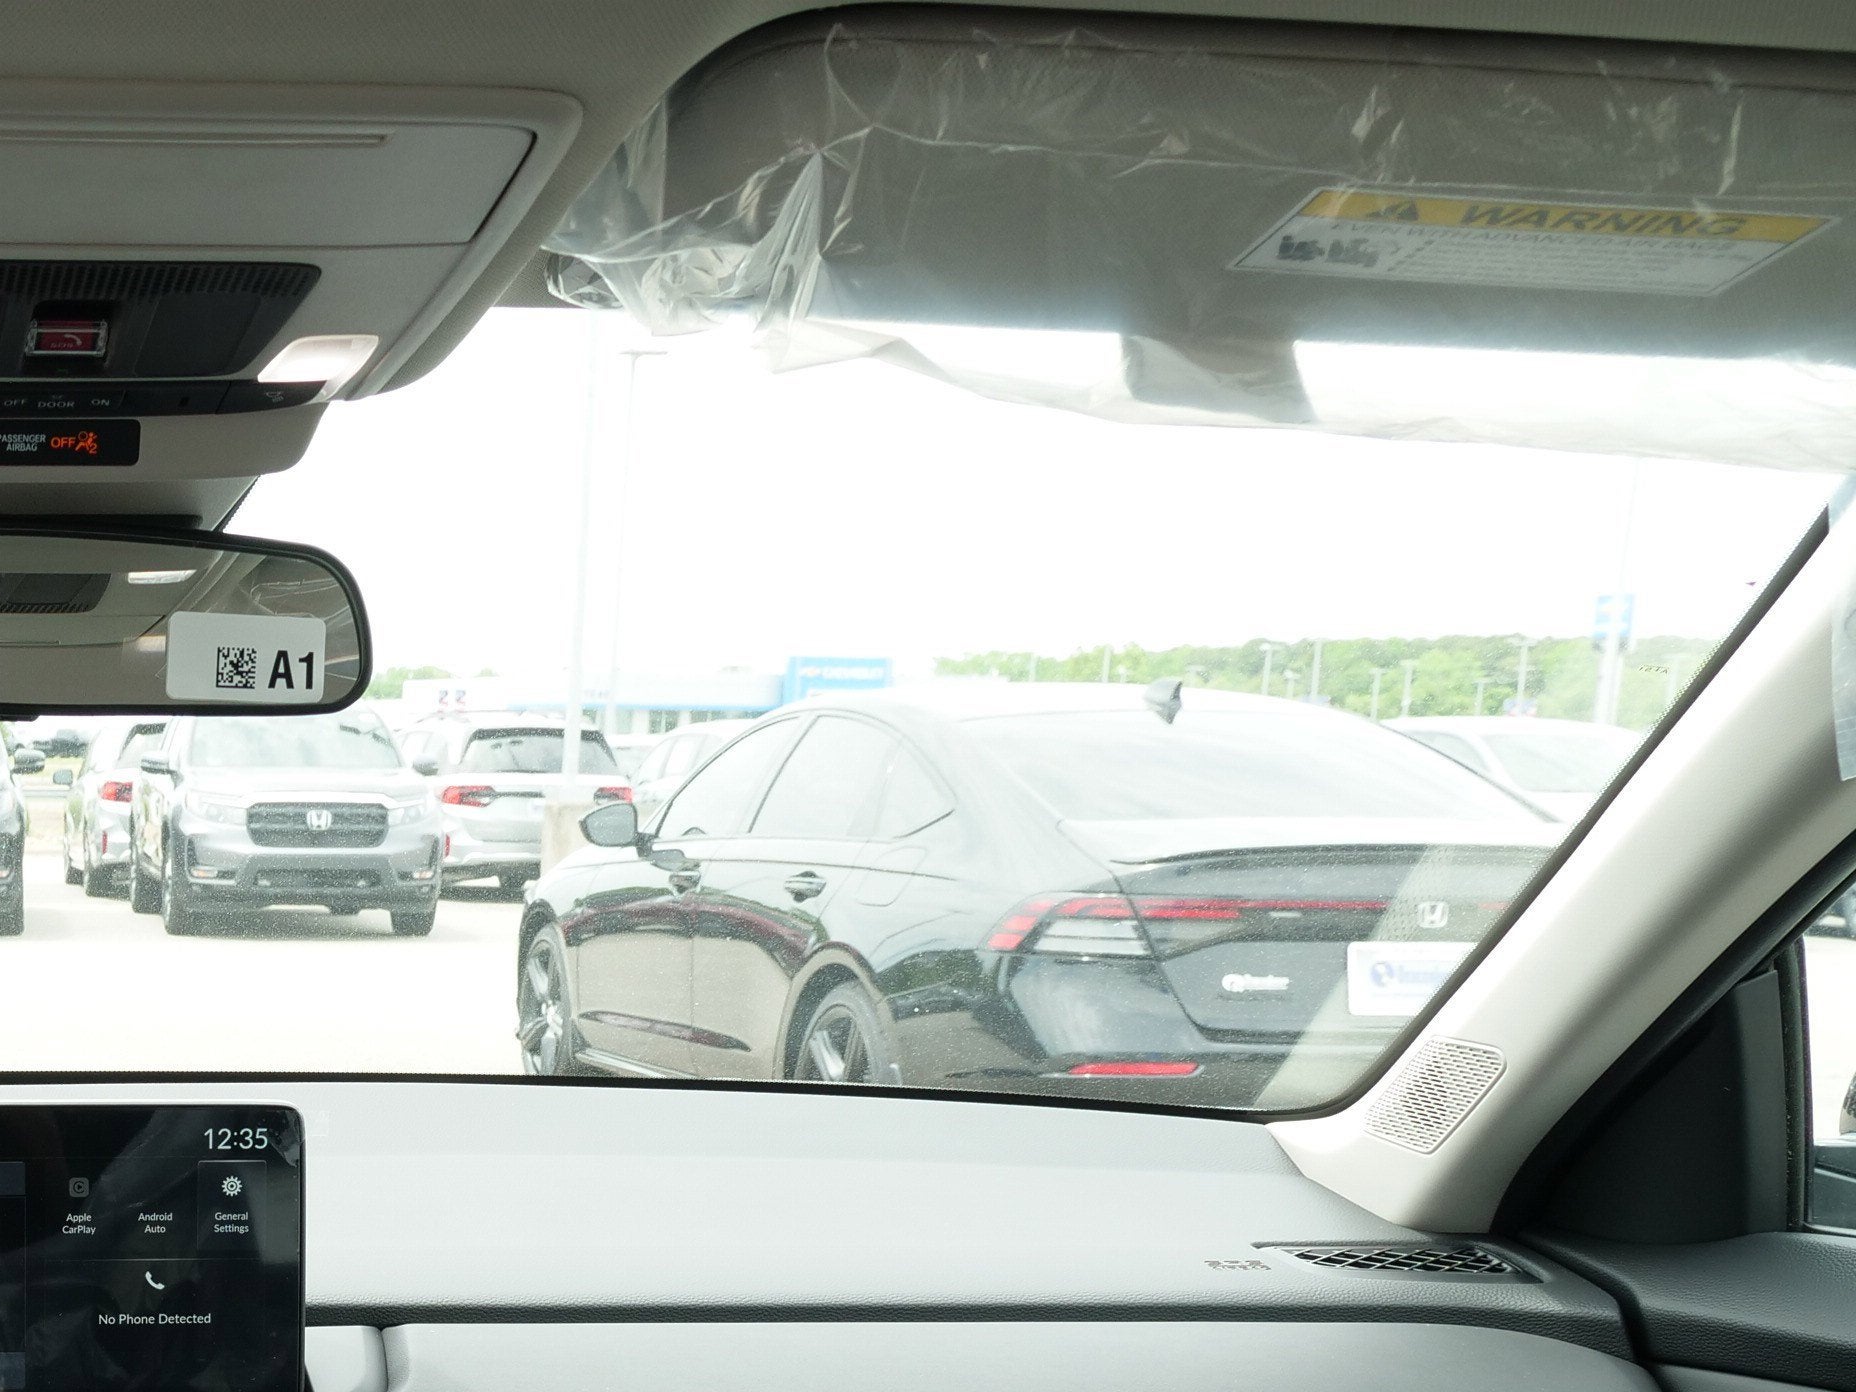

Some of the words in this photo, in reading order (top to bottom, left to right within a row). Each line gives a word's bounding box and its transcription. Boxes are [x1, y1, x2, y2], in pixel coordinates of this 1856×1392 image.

[1460, 205, 1748, 236] WARNING
[6, 443, 38, 452] AIRBAG
[50, 437, 76, 449] OFF
[267, 650, 316, 690] A1
[204, 1128, 268, 1150] 12:35
[66, 1213, 92, 1225] Apple
[138, 1212, 173, 1222] Android
[214, 1211, 249, 1222] General
[62, 1224, 96, 1236] CarPlay
[144, 1223, 166, 1233] Auto
[213, 1223, 249, 1235] Settings
[98, 1313, 115, 1324] No
[118, 1313, 155, 1324] Phone
[158, 1313, 212, 1324] Detected
